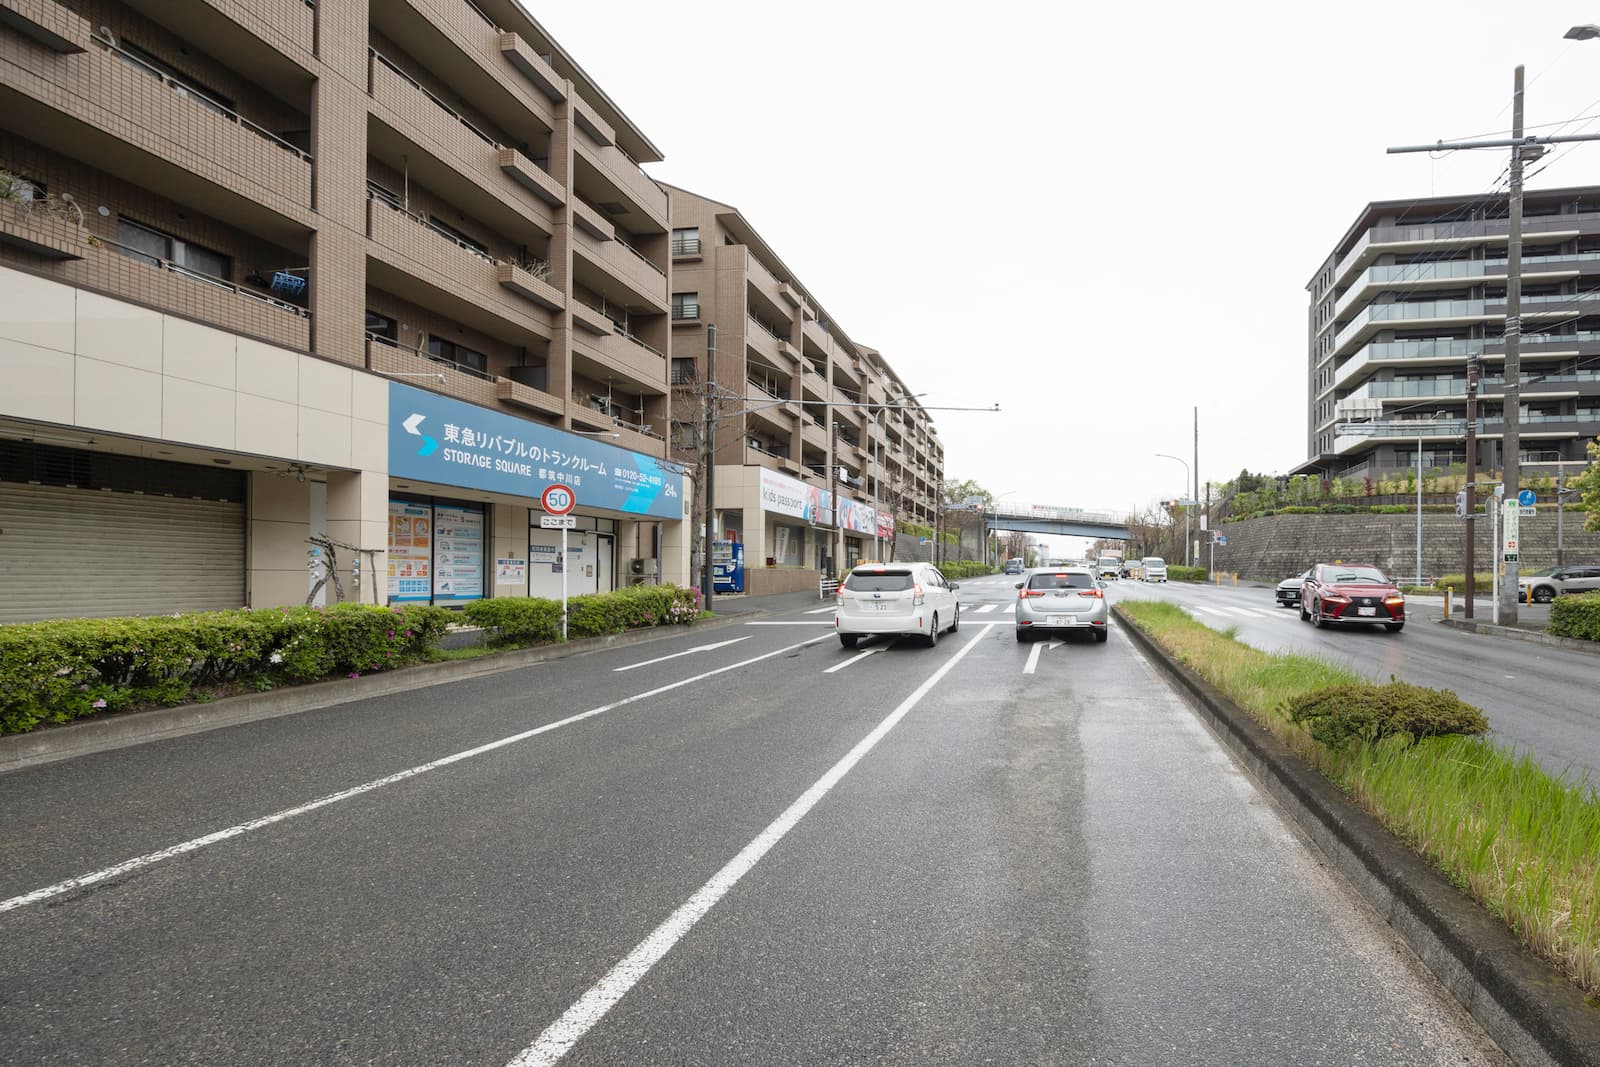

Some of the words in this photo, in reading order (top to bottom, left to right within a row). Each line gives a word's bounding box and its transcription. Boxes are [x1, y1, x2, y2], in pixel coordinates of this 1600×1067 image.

[443, 423, 607, 476] 東急リバブルのトランクルーム
[443, 447, 492, 469] STORAGE
[495, 458, 532, 477] SQUARE
[539, 468, 581, 486] 都筑中川店
[549, 493, 568, 507] 50
[763, 487, 776, 503] kids
[543, 518, 573, 526] ここまで
